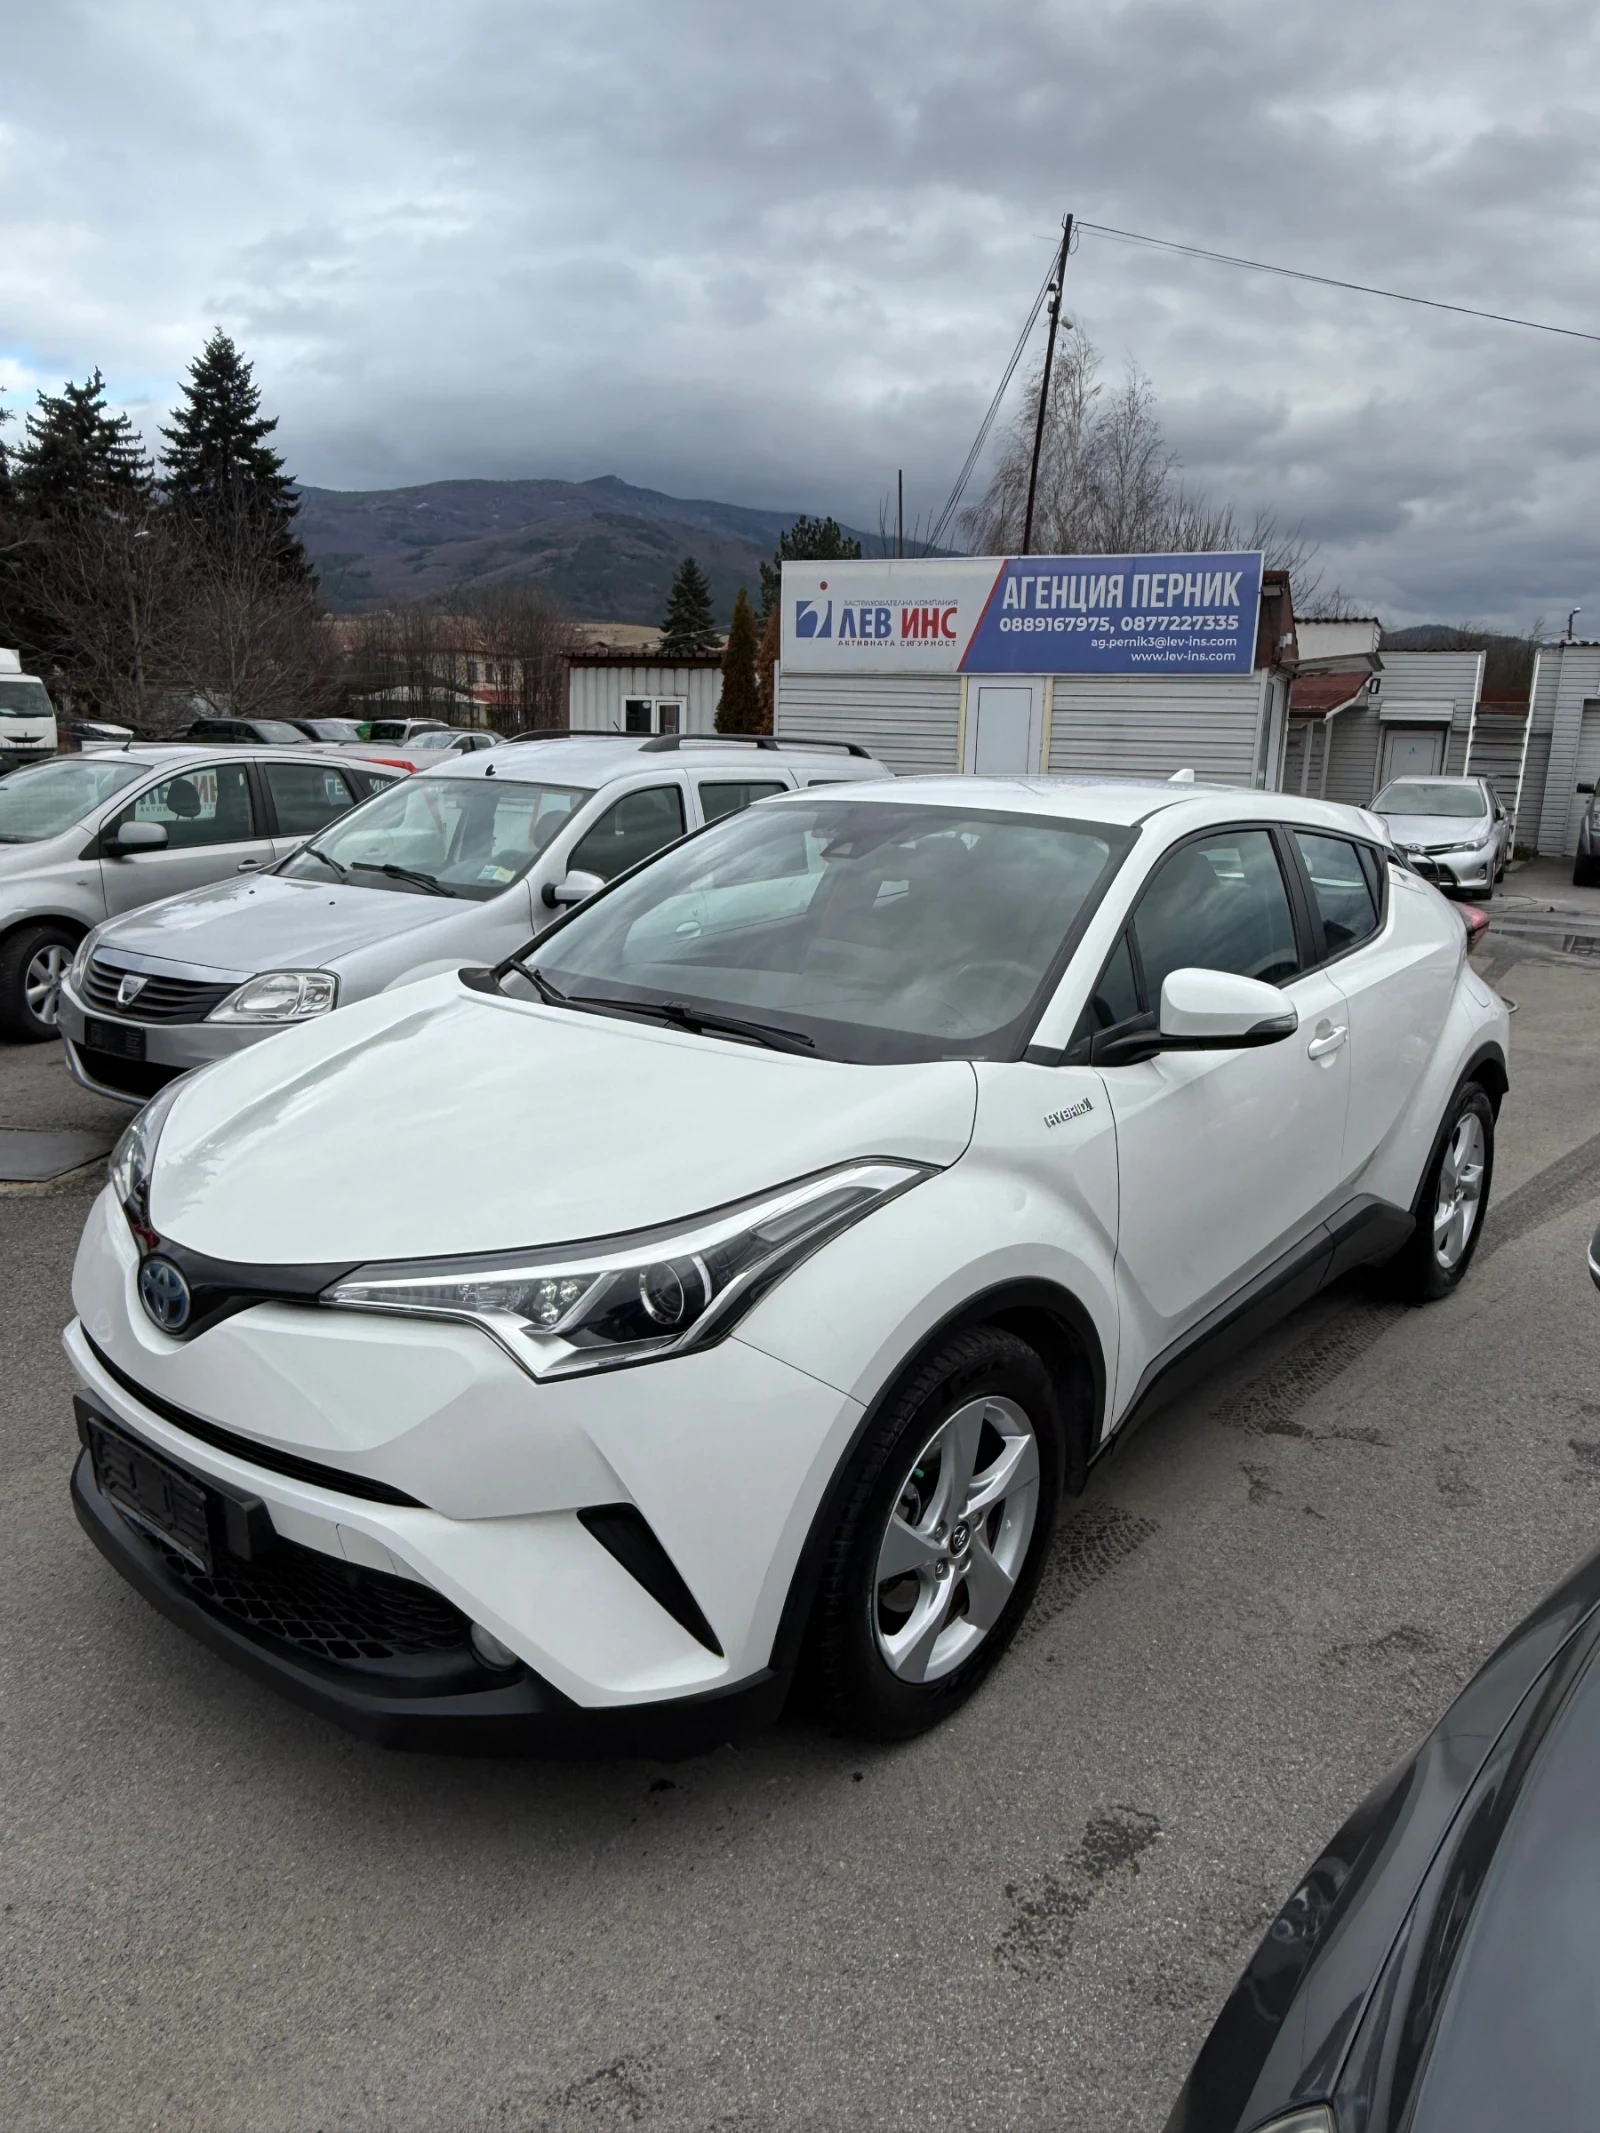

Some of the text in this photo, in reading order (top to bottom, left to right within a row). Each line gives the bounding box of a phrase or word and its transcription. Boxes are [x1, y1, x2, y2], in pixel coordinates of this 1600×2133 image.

[1002, 571, 1243, 613] АГЕНЦИЯ ПЕРНИК
[914, 598, 958, 606] КОМПАНИЯ
[838, 606, 958, 639] ЛЕВ ИНС
[999, 615, 1239, 634] 0889167975, 0877227335
[838, 639, 957, 647] АКТИВНАТА СИГУРНОСТ
[1090, 636, 1238, 650] ag.pernik3@lev-ins.com
[1130, 650, 1236, 662] www.lev-ins.com
[1043, 1098, 1091, 1128] HYBRID
